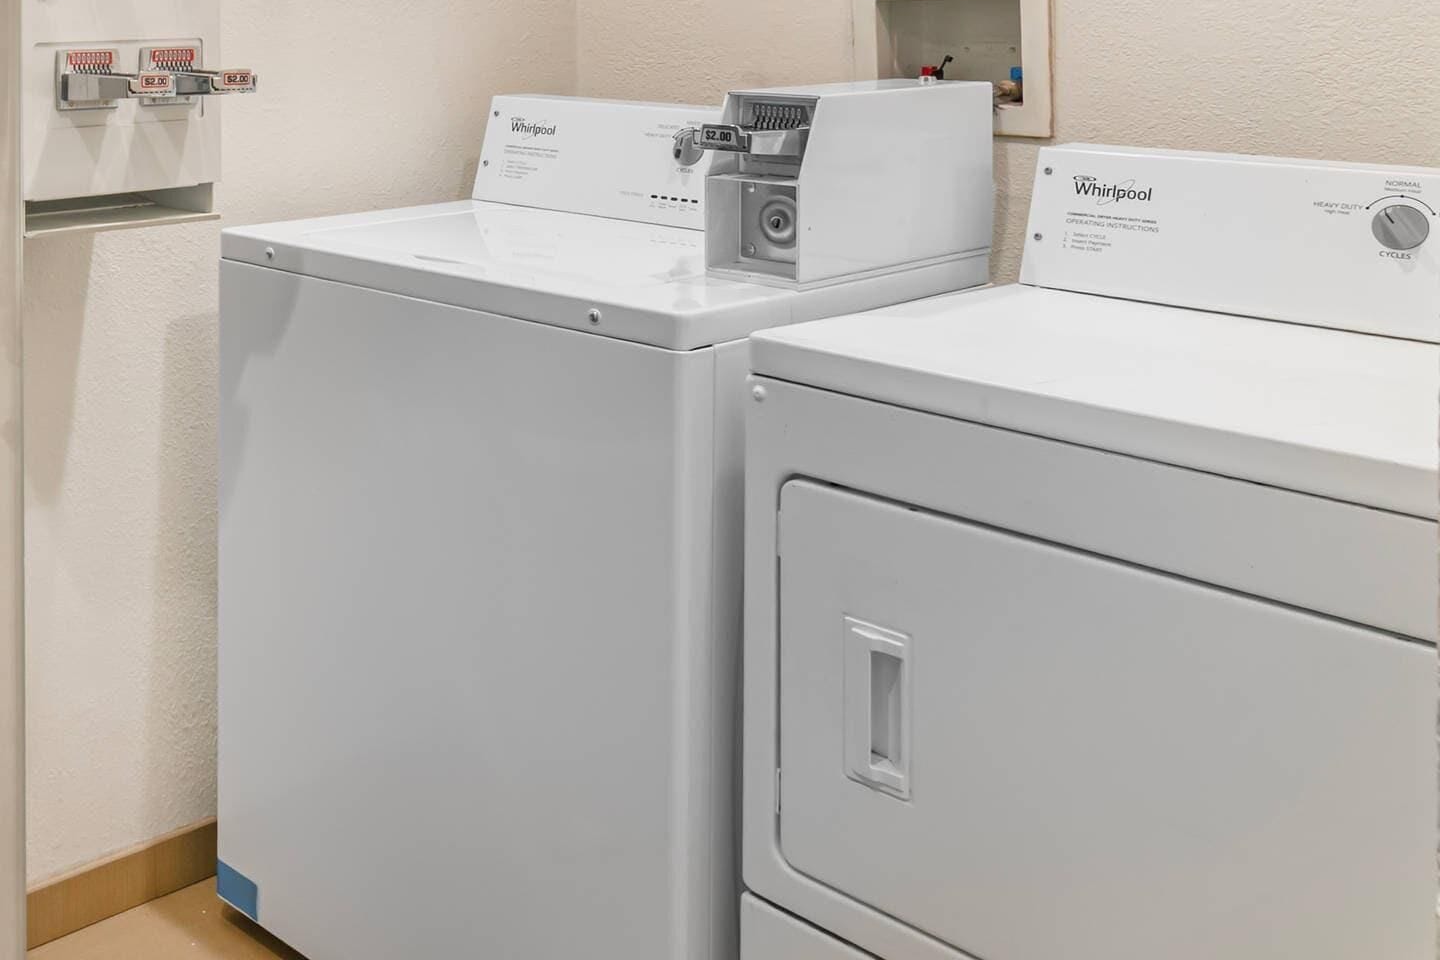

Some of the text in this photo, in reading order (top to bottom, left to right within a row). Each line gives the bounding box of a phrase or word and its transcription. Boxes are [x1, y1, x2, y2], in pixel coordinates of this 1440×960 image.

[511, 121, 557, 137] Whirlpool
[705, 130, 732, 142] $2.00
[1385, 179, 1423, 189] NORMAL
[1074, 181, 1153, 203] Whirlpool
[1065, 218, 1160, 233] OPERATING INSTRUCTIONS
[1378, 250, 1412, 260] CYCLES
